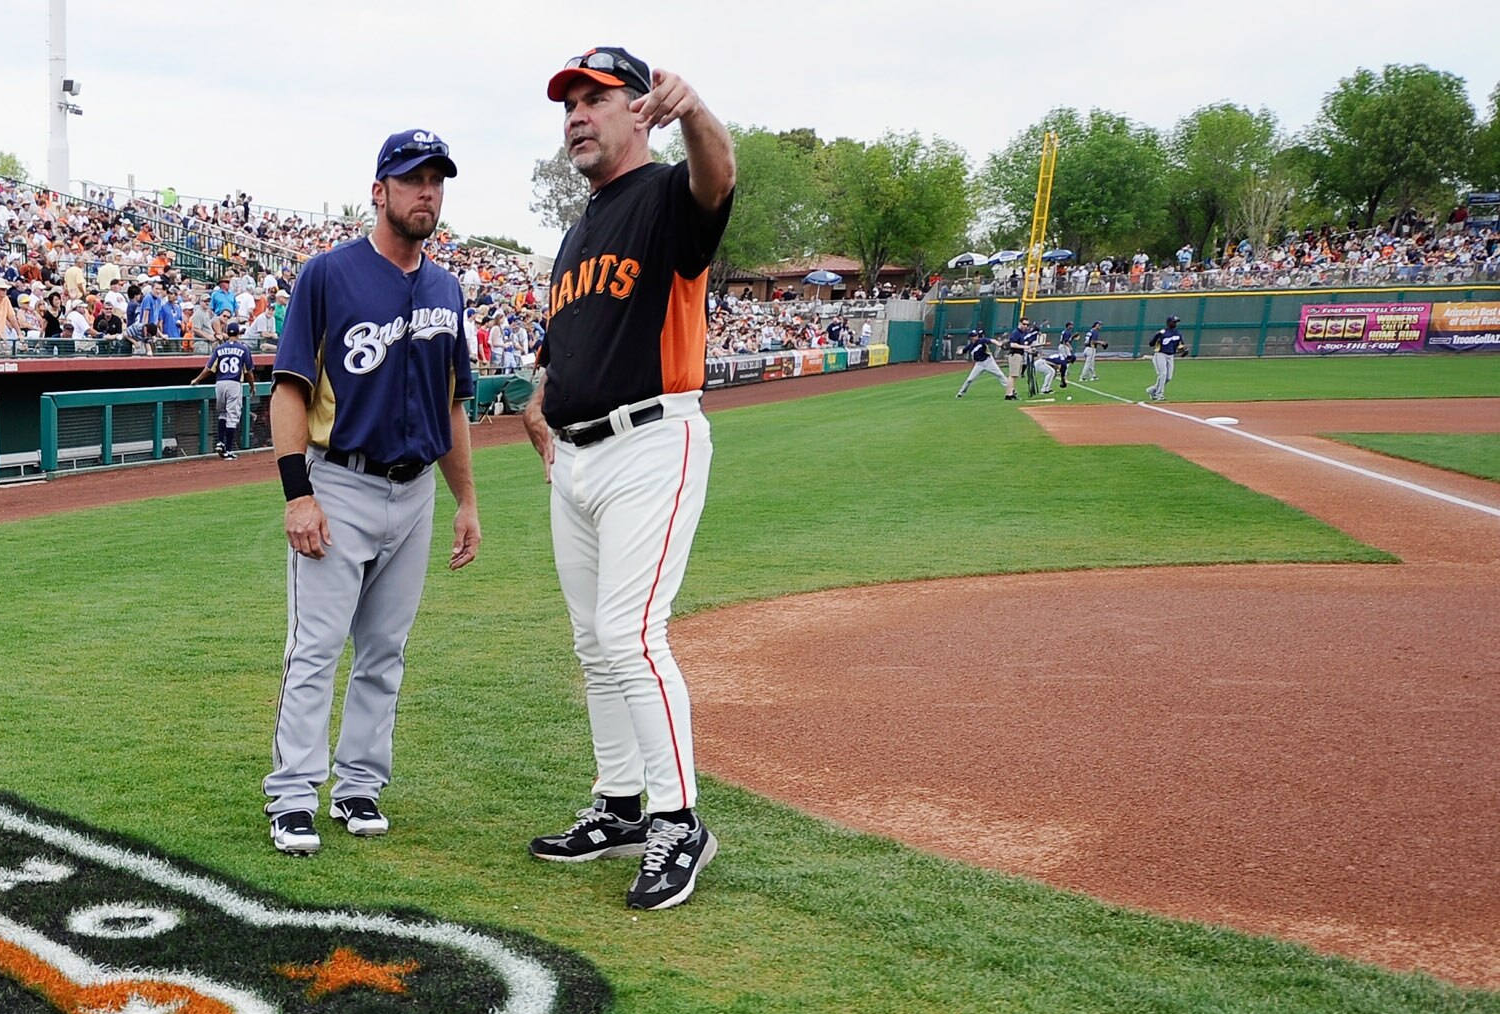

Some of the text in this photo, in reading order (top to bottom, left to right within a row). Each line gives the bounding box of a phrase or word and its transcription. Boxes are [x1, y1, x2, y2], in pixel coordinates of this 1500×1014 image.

[547, 254, 641, 322] IANTS
[1390, 305, 1424, 313] CASINO
[1376, 314, 1419, 325] WINNERS
[344, 307, 458, 375] Brewers
[1368, 330, 1396, 341] HOME
[1398, 330, 1420, 341] RUN
[1316, 342, 1400, 350] 1-800-THE-FORT
[219, 356, 240, 374] 68
